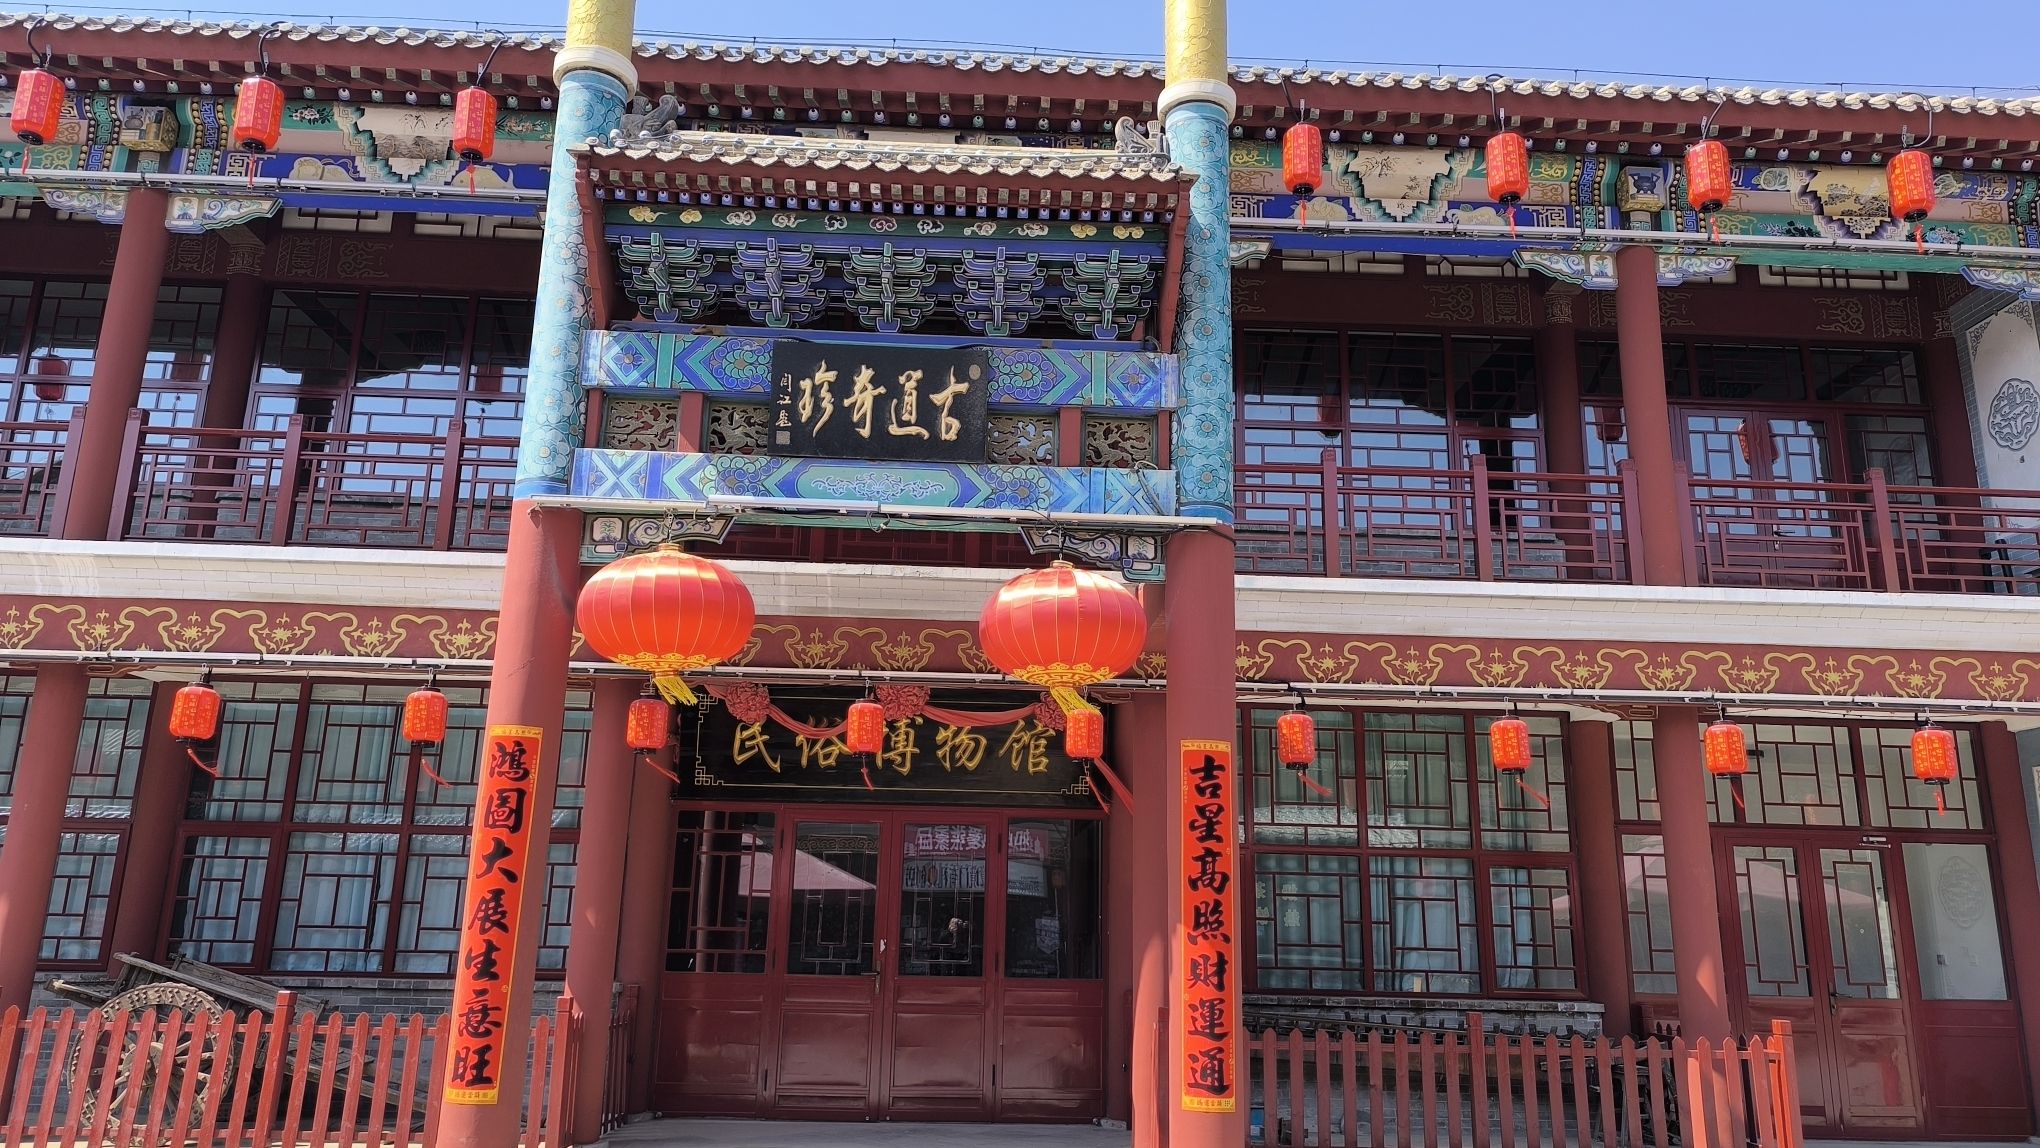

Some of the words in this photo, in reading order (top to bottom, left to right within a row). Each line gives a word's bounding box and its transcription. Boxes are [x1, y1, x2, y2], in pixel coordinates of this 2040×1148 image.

[733, 714, 1056, 776] 民俗博物馆
